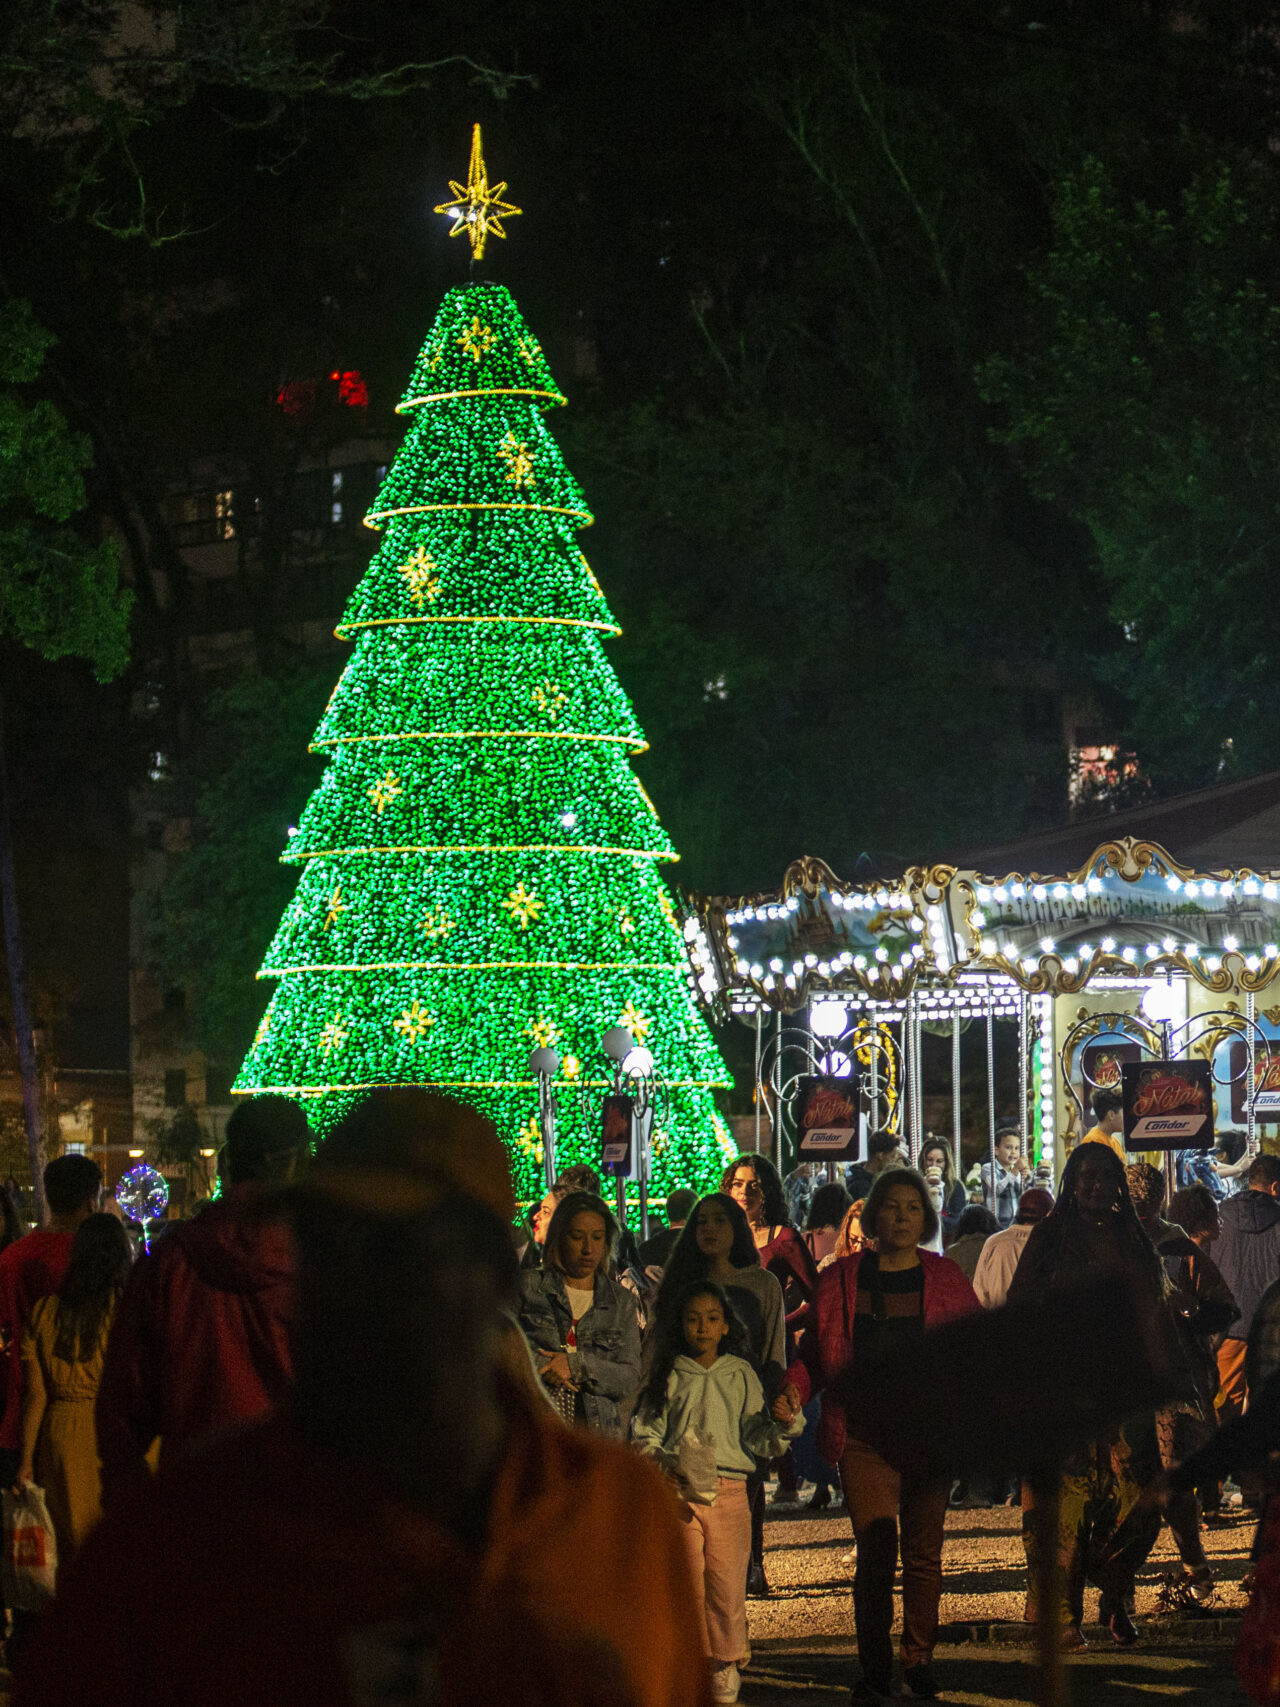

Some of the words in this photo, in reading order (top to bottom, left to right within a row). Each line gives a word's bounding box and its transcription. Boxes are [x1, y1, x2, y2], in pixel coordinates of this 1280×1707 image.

[1132, 1080, 1202, 1116] Natal
[803, 1095, 852, 1128] Natal
[1144, 1120, 1190, 1130] Condor
[810, 1133, 842, 1141] Condor
